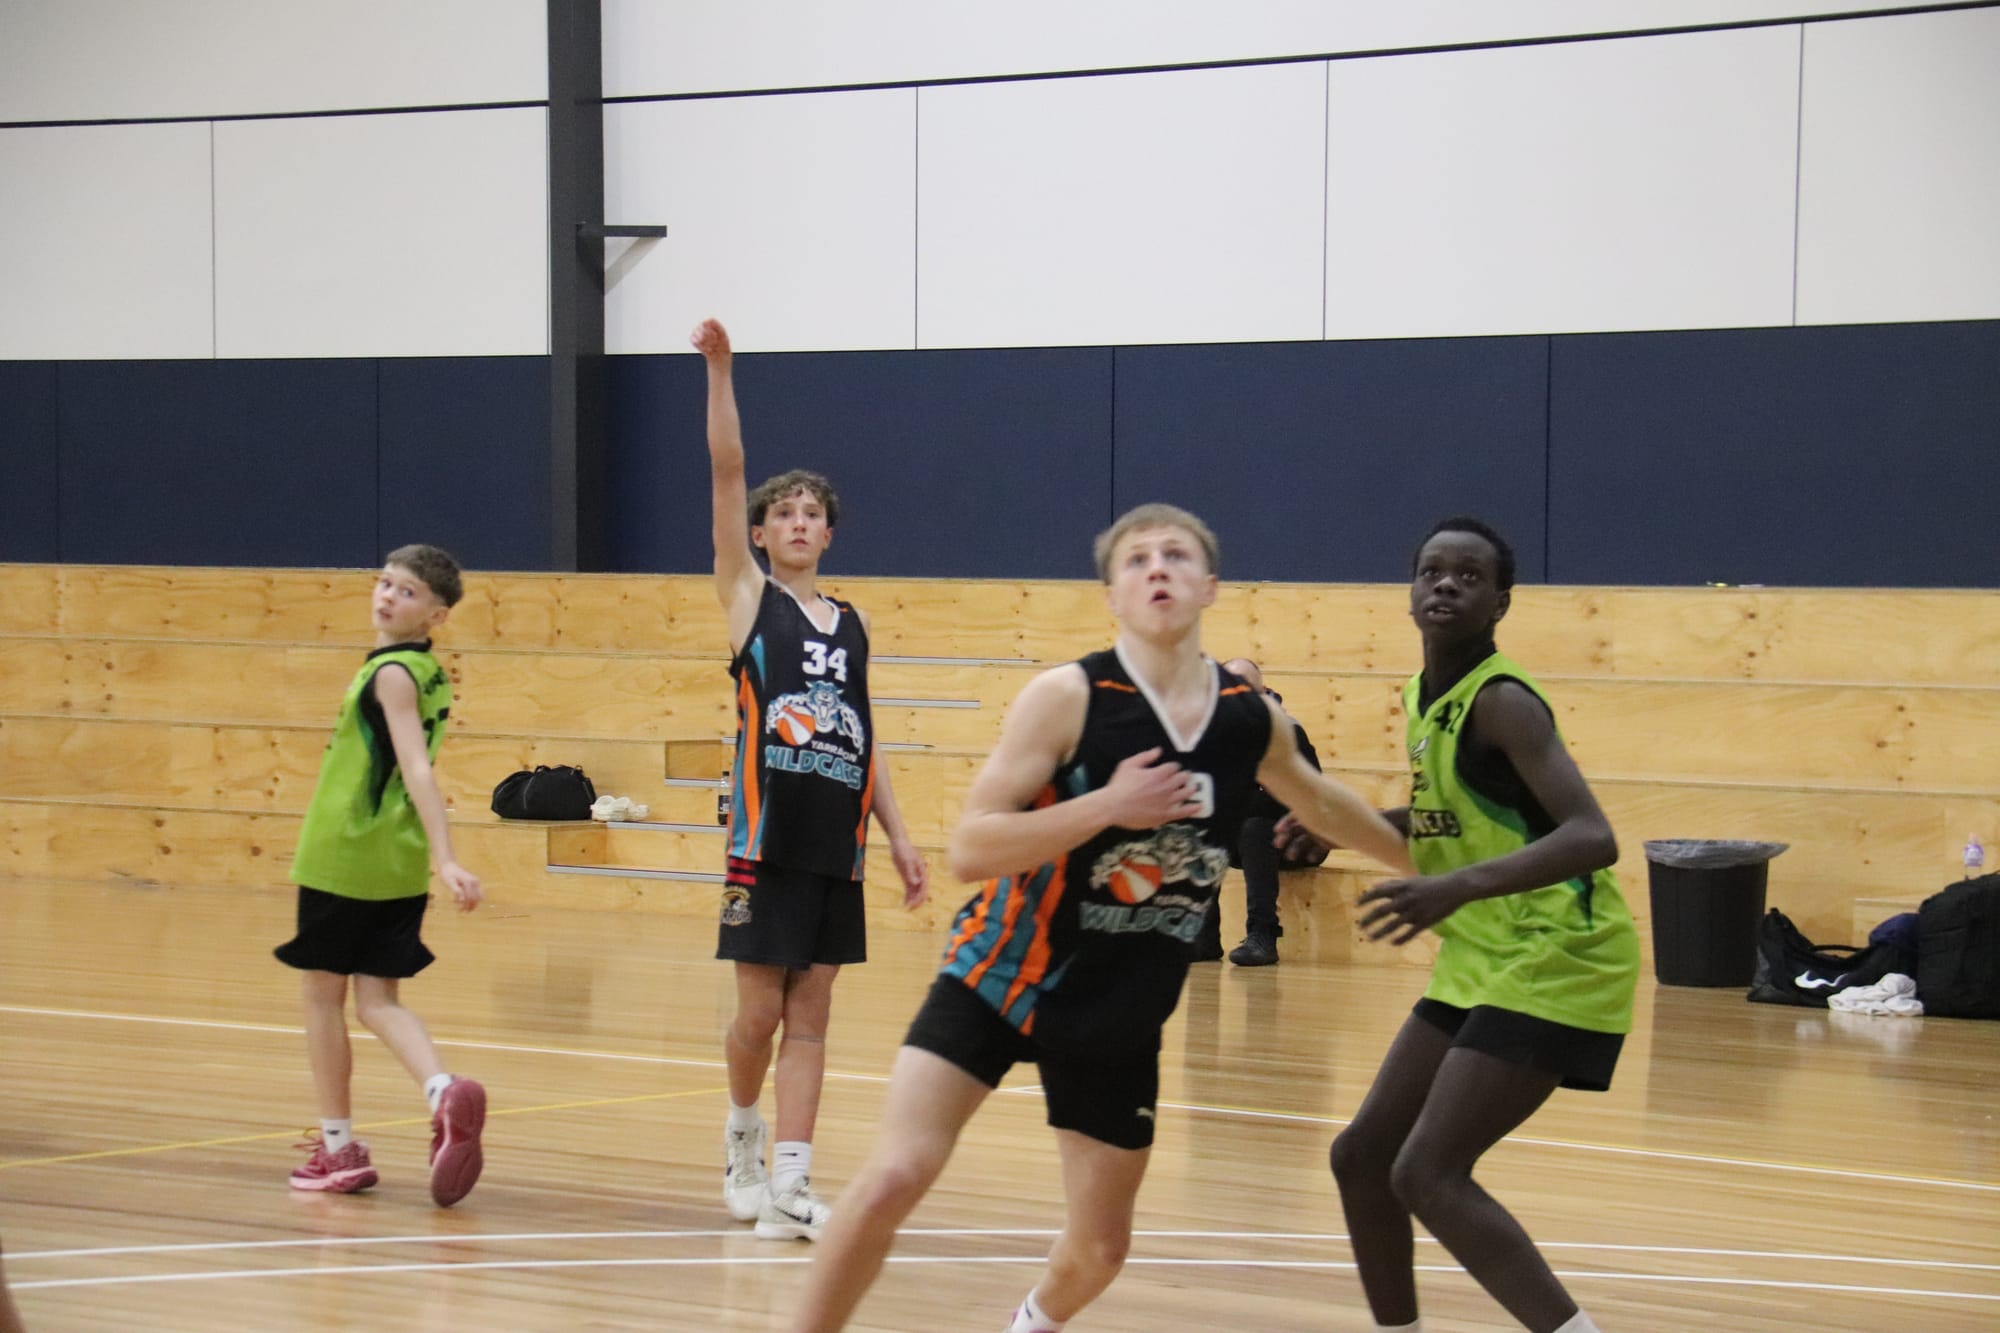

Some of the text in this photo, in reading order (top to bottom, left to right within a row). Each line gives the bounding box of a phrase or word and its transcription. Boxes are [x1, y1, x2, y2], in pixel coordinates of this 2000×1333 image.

[802, 640, 848, 682] 34
[765, 745, 863, 790] WILDCAS
[811, 740, 858, 762] YARRAON
[1080, 901, 1205, 943] WILDCA
